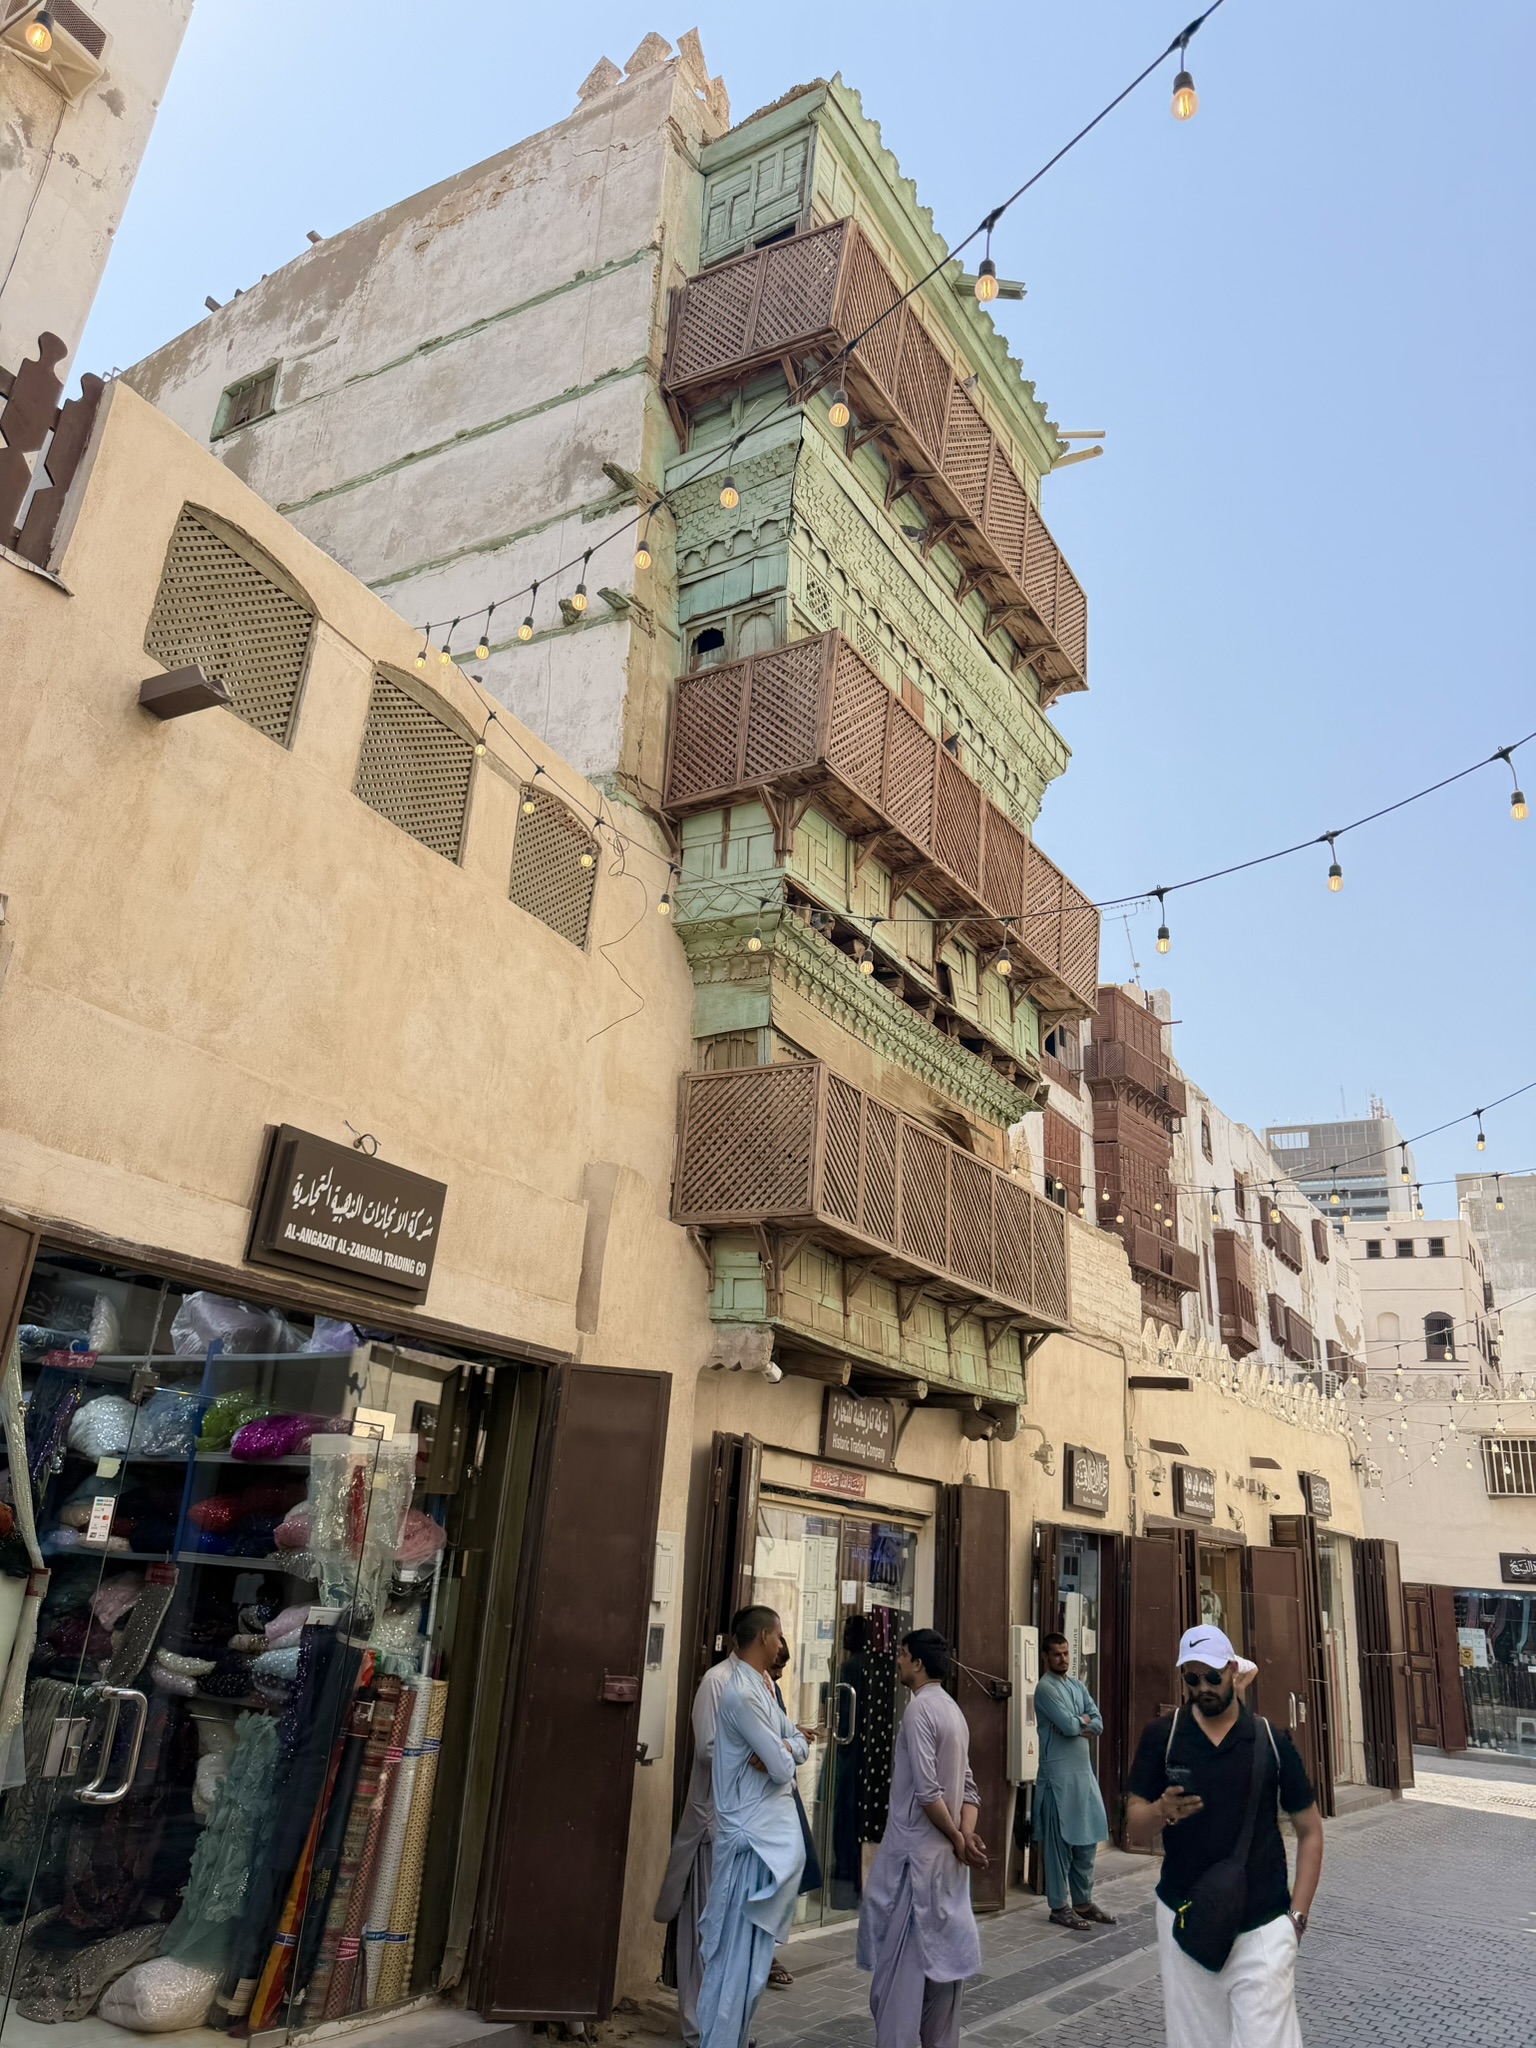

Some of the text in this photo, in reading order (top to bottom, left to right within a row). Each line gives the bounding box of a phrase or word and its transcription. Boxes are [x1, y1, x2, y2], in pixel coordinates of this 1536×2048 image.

[292, 1166, 334, 1216] التجارية
[331, 1186, 364, 1224] الذهبية
[407, 1208, 434, 1241] شركة
[284, 1223, 427, 1277] AL-ANGAZAT AL-ZAHABIA TRADING CO
[832, 1433, 886, 1464] Historic Trading Company
